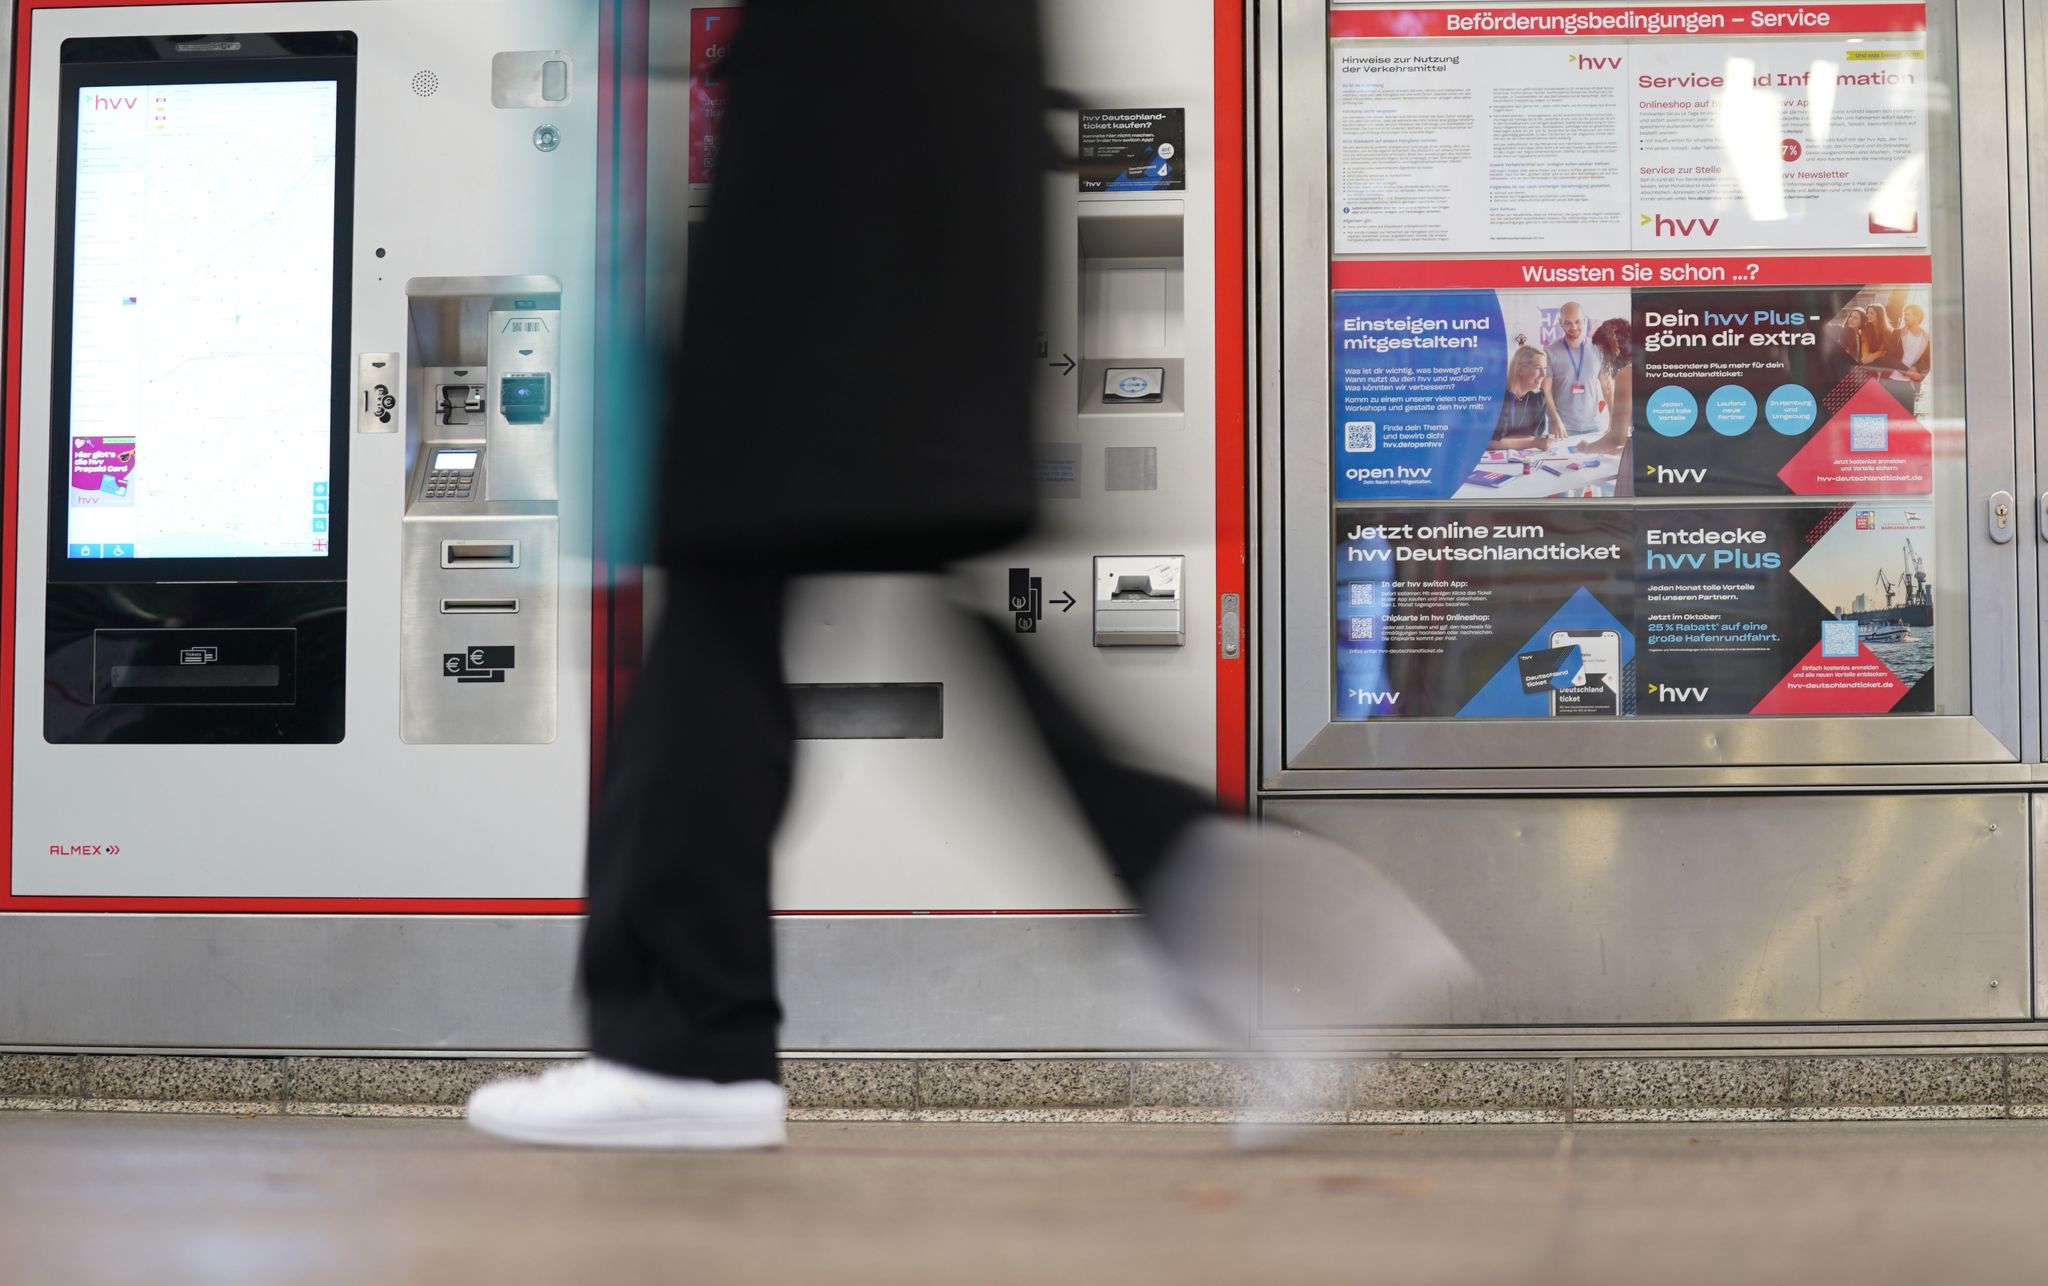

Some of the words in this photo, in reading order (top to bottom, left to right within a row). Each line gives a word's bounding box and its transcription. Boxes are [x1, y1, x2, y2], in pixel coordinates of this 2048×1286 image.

[1446, 11, 1725, 33] Beförderungsbedingungen
[1751, 9, 1830, 27] Service
[1342, 56, 1391, 64] Hinweise
[1413, 54, 1459, 66] Nutzung
[1578, 54, 1622, 70] hvv
[1342, 64, 1360, 73] der
[1363, 64, 1446, 73] Verkehrsmittel
[1638, 72, 1724, 88] Service
[1778, 70, 1914, 86] Infmation
[94, 94, 138, 110] hvv
[1640, 100, 1692, 109] Onlineshop
[1694, 100, 1710, 108] auf
[1797, 98, 1809, 108] Ap
[1640, 166, 1675, 174] Service
[1696, 166, 1722, 174] Stelle
[1798, 170, 1849, 179] Newsletter
[1656, 214, 1720, 236] hvv
[1522, 264, 1615, 282] Wussten
[1621, 264, 1654, 282] Sie
[1659, 263, 1726, 281] schon
[1344, 317, 1448, 333] Einsteigen
[1452, 317, 1489, 330] und
[1645, 310, 1698, 327] Dein
[1704, 310, 1748, 326] hvv
[1754, 310, 1804, 326] Plus
[1344, 335, 1478, 352] mitgestalten!
[1645, 332, 1706, 352] gönn
[1712, 329, 1744, 347] dir
[1749, 332, 1816, 346] extra
[1405, 404, 1435, 412] gestalte
[92, 451, 116, 459] gibt's
[1346, 467, 1393, 481] open
[1398, 466, 1432, 478] hvv
[1658, 466, 1707, 484] hvv
[78, 496, 98, 504] hvv
[1348, 524, 1412, 540] Jetzt
[1418, 522, 1488, 539] online
[1493, 526, 1544, 538] zum
[1647, 529, 1766, 544] Entdecke
[1348, 546, 1391, 562] hvv
[1396, 544, 1620, 561] Deutschlandticket
[1647, 550, 1706, 570] hvv
[1714, 550, 1781, 569] Plus
[1721, 622, 1740, 631] auf
[1743, 622, 1768, 630] eine
[1648, 634, 1683, 644] große
[1685, 633, 1780, 642] Hafenrundfahrt.
[1525, 670, 1568, 681] Deutschland
[1358, 689, 1400, 705] hvv
[1660, 684, 1709, 702] hvv
[50, 845, 101, 855] ALMEX
